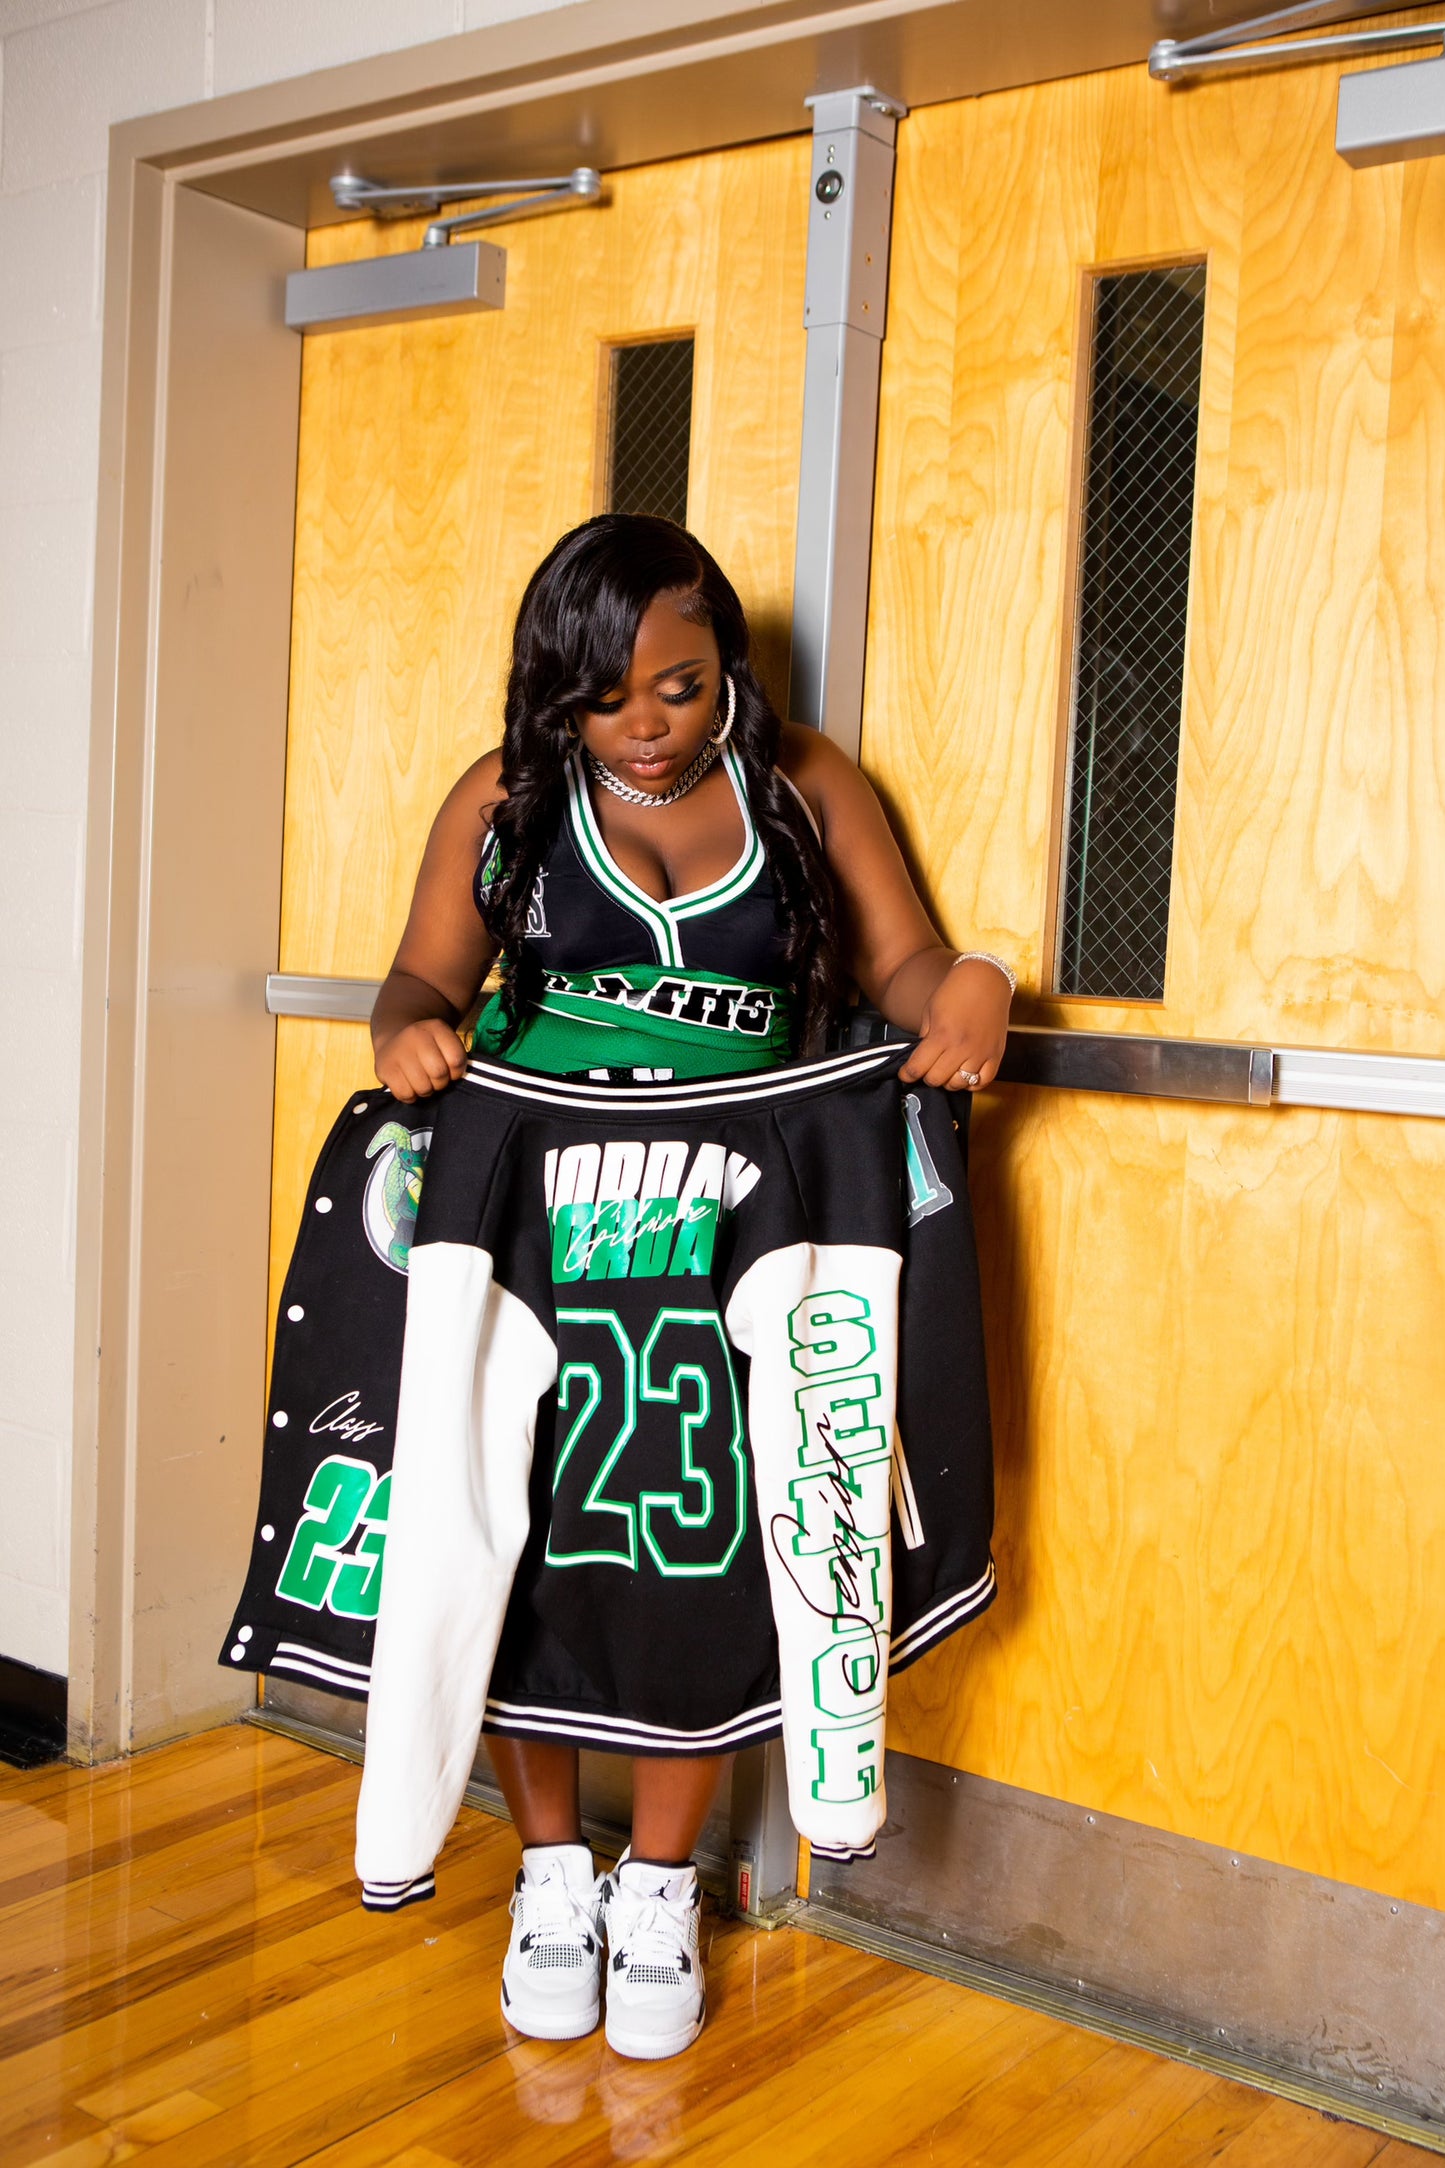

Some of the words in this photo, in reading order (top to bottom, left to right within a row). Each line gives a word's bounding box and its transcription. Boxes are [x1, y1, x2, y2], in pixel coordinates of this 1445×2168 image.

[309, 1391, 384, 1442] Class
[545, 1306, 747, 1578] 23
[275, 1454, 393, 1621] 23
